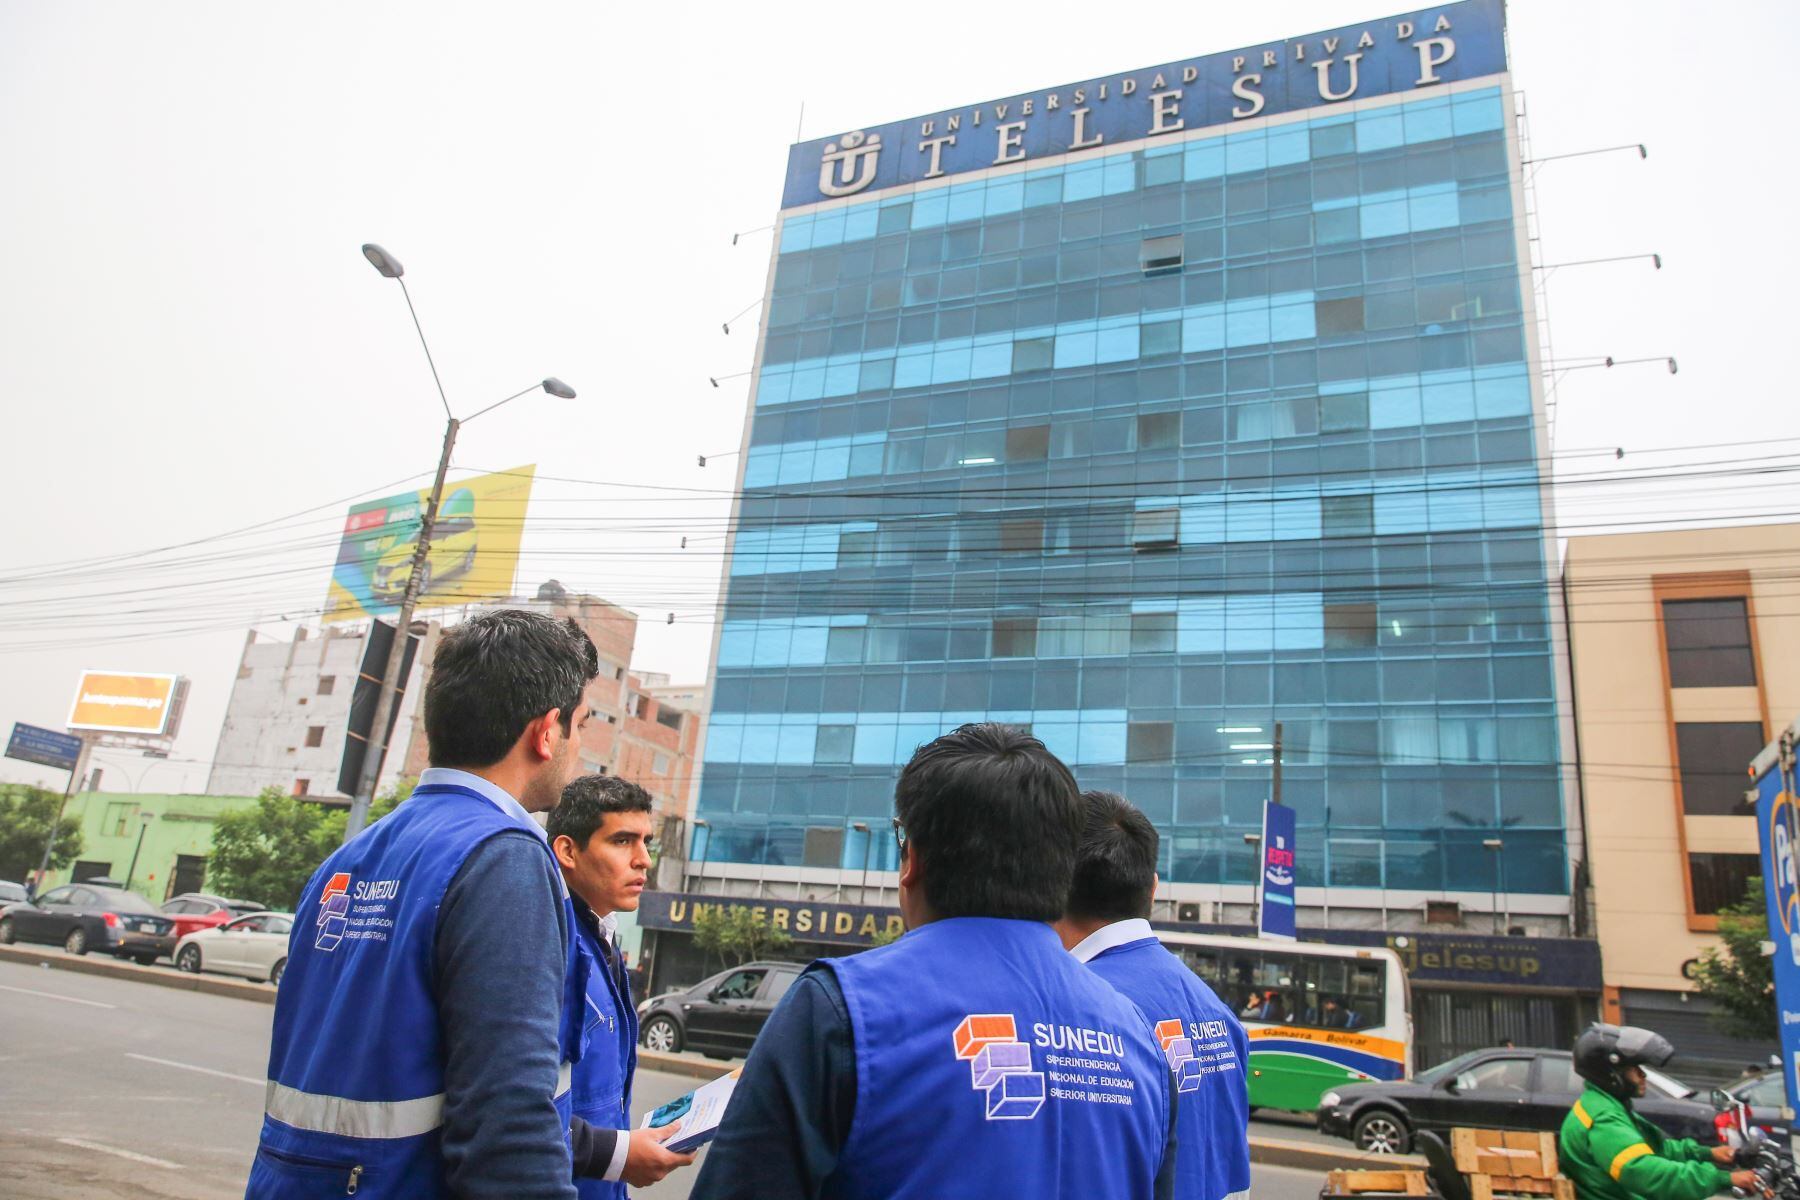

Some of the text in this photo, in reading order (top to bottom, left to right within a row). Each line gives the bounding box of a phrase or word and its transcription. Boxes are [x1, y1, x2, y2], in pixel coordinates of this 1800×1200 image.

[921, 14, 1451, 137] UNIVERSIDAD PRIVADA
[919, 36, 1456, 178] TELESUP
[353, 880, 400, 901] SUNEDU
[1033, 1022, 1125, 1058] SUNEDU
[1190, 1020, 1228, 1040] SUNEDU
[1263, 1028, 1312, 1040] Gamarra
[1088, 1075, 1098, 1085] DE
